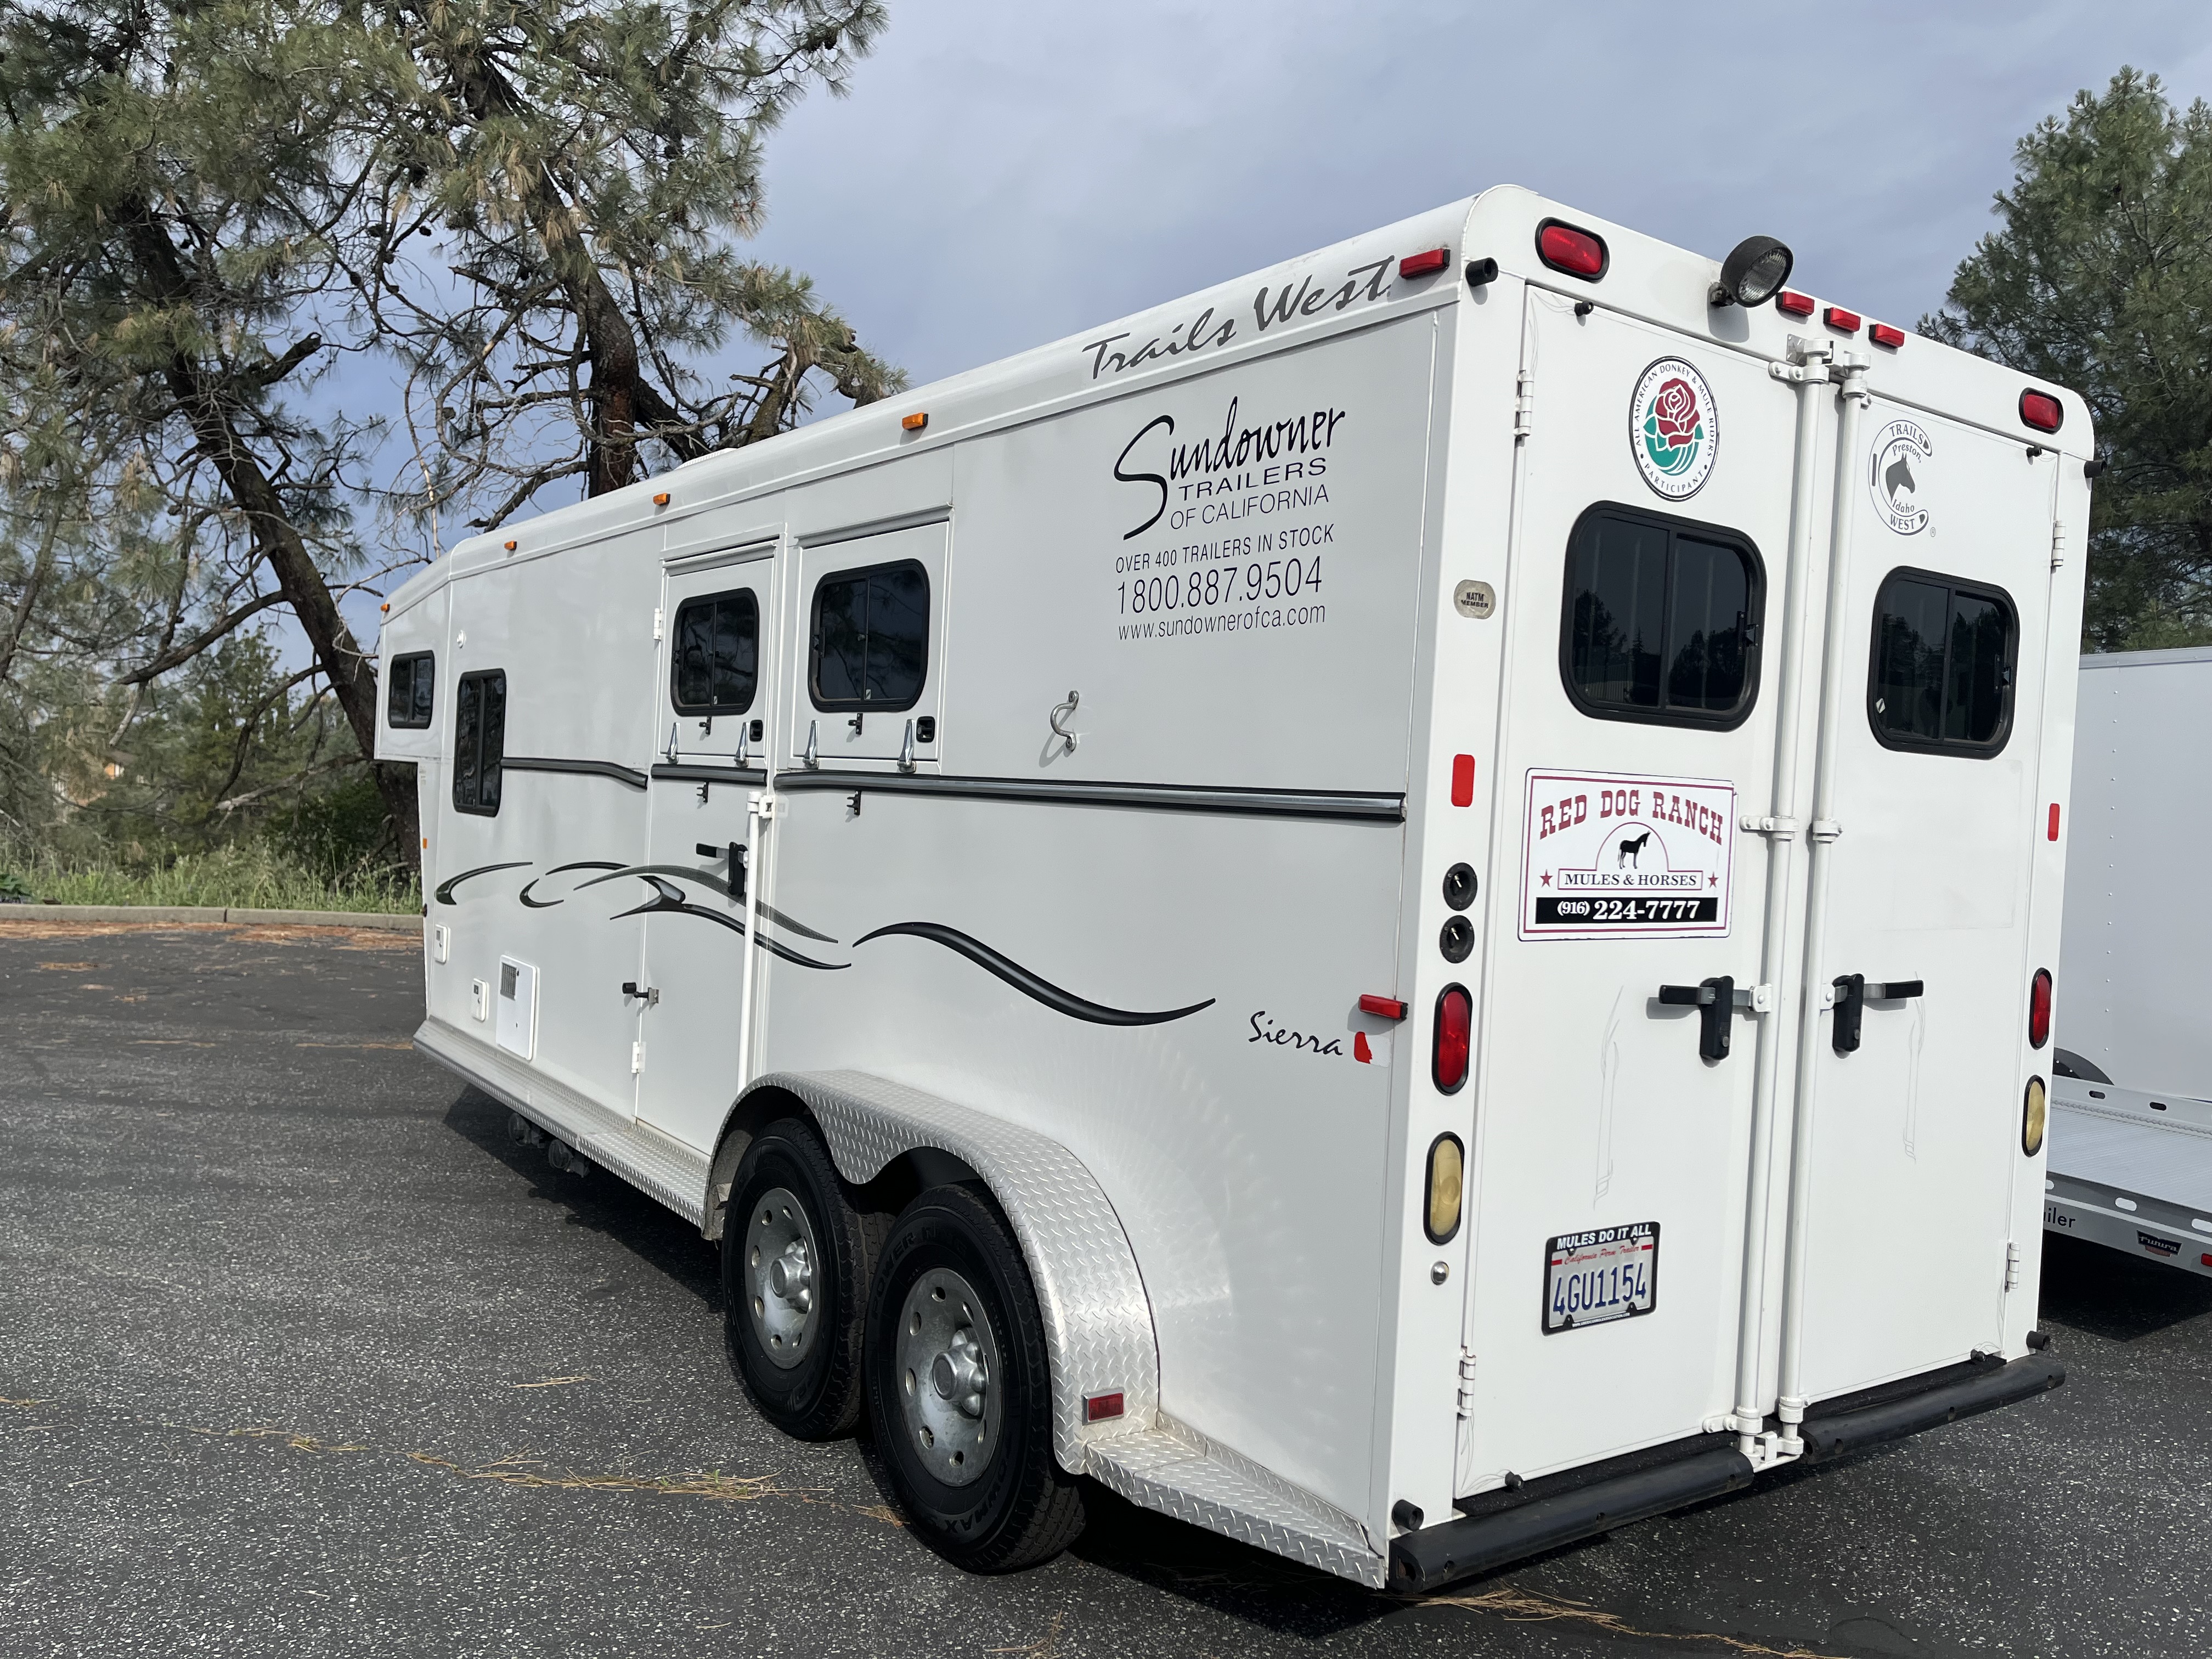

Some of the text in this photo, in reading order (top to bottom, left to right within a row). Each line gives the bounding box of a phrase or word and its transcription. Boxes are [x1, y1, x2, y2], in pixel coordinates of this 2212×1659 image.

[1082, 255, 1395, 380] Trails West
[1634, 370, 1658, 421] AMERICAN
[1660, 364, 1691, 377] DONKEY
[1692, 376, 1697, 384] &
[1697, 385, 1713, 413] MULE
[1707, 417, 1716, 458] RIDERS
[1889, 424, 1924, 444] TRAILS
[1113, 396, 1345, 540] Sundowner
[1179, 458, 1327, 501] TRAILERS
[1644, 463, 1704, 493] PARTICIPANT
[1170, 484, 1329, 530] OF CALIFORNIA
[1890, 514, 1915, 530] WEST
[1892, 499, 1915, 514] Idaho
[1116, 523, 1334, 574] OVER 400 TRAILERS IN STOCK
[1117, 555, 1323, 614] 1800.887.9504
[1461, 592, 1488, 608] NATM MEMBER
[1118, 603, 1326, 641] www.sundownerofca.com
[1540, 789, 1723, 845] RED DOG RANCH
[1565, 873, 1696, 886] MULES & HORSES
[1557, 900, 1700, 919] (916) 224-7777
[1248, 1011, 1343, 1056] Sierra
[1557, 1224, 1651, 1250] MULES DO IT ALL
[2044, 1207, 2076, 1228] iler
[1553, 1262, 1646, 1316] 4GU1154
